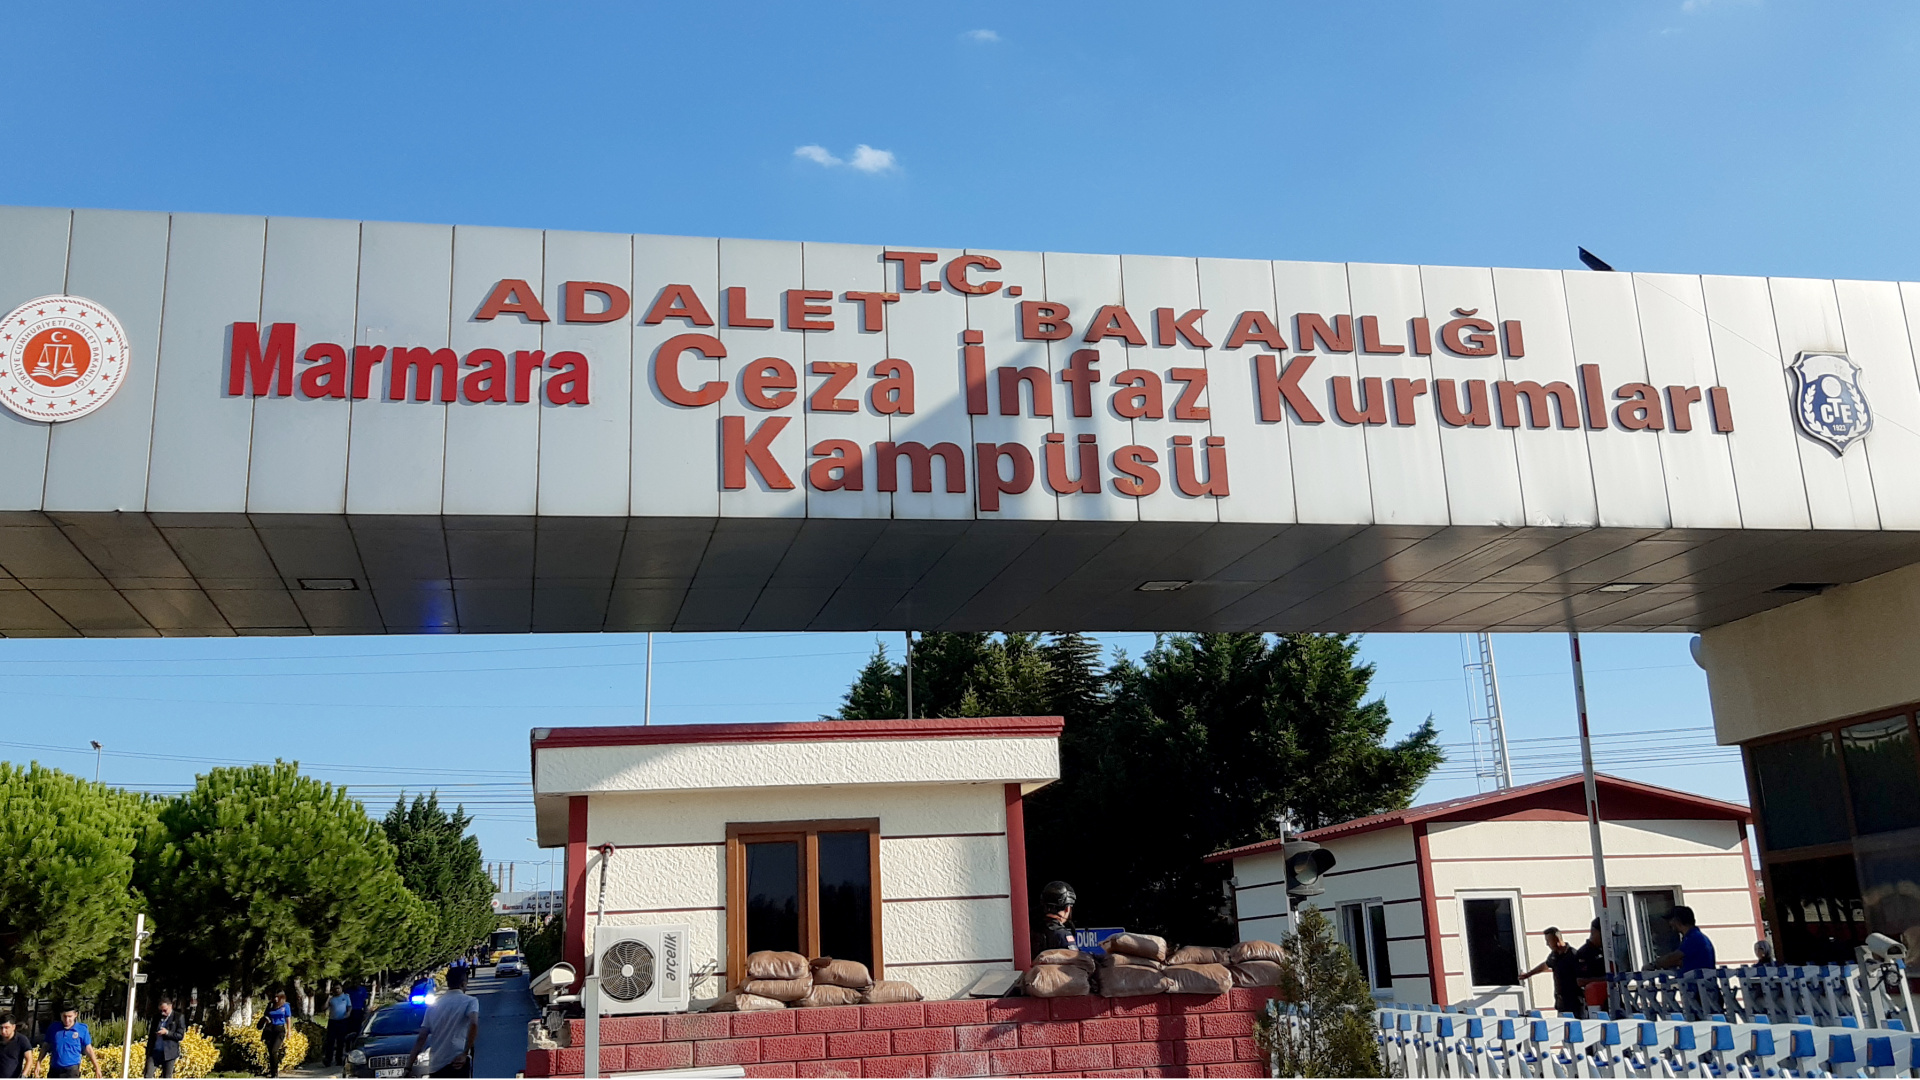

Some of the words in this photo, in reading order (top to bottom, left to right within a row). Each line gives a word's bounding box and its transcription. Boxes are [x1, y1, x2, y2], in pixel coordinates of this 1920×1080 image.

[884, 251, 1023, 295] T.C.
[15, 320, 66, 355] CUMHURİYETİ
[69, 322, 97, 345] ADALET
[476, 280, 900, 332] ADALET
[1021, 300, 1525, 357] BAKANLIĞI
[14, 357, 35, 389] TÜRKİYE
[75, 346, 100, 389] BAKANLIĞI
[228, 321, 590, 405] Marmara
[655, 333, 915, 414] Ceza
[964, 329, 1211, 420] İnfaz
[1256, 355, 1734, 431] Kurumları
[1820, 397, 1854, 424] CTE
[1832, 424, 1847, 432] 1923
[722, 416, 1231, 511] Kampüsü
[664, 933, 679, 981] arçelik
[1076, 931, 1098, 948] DUR!
